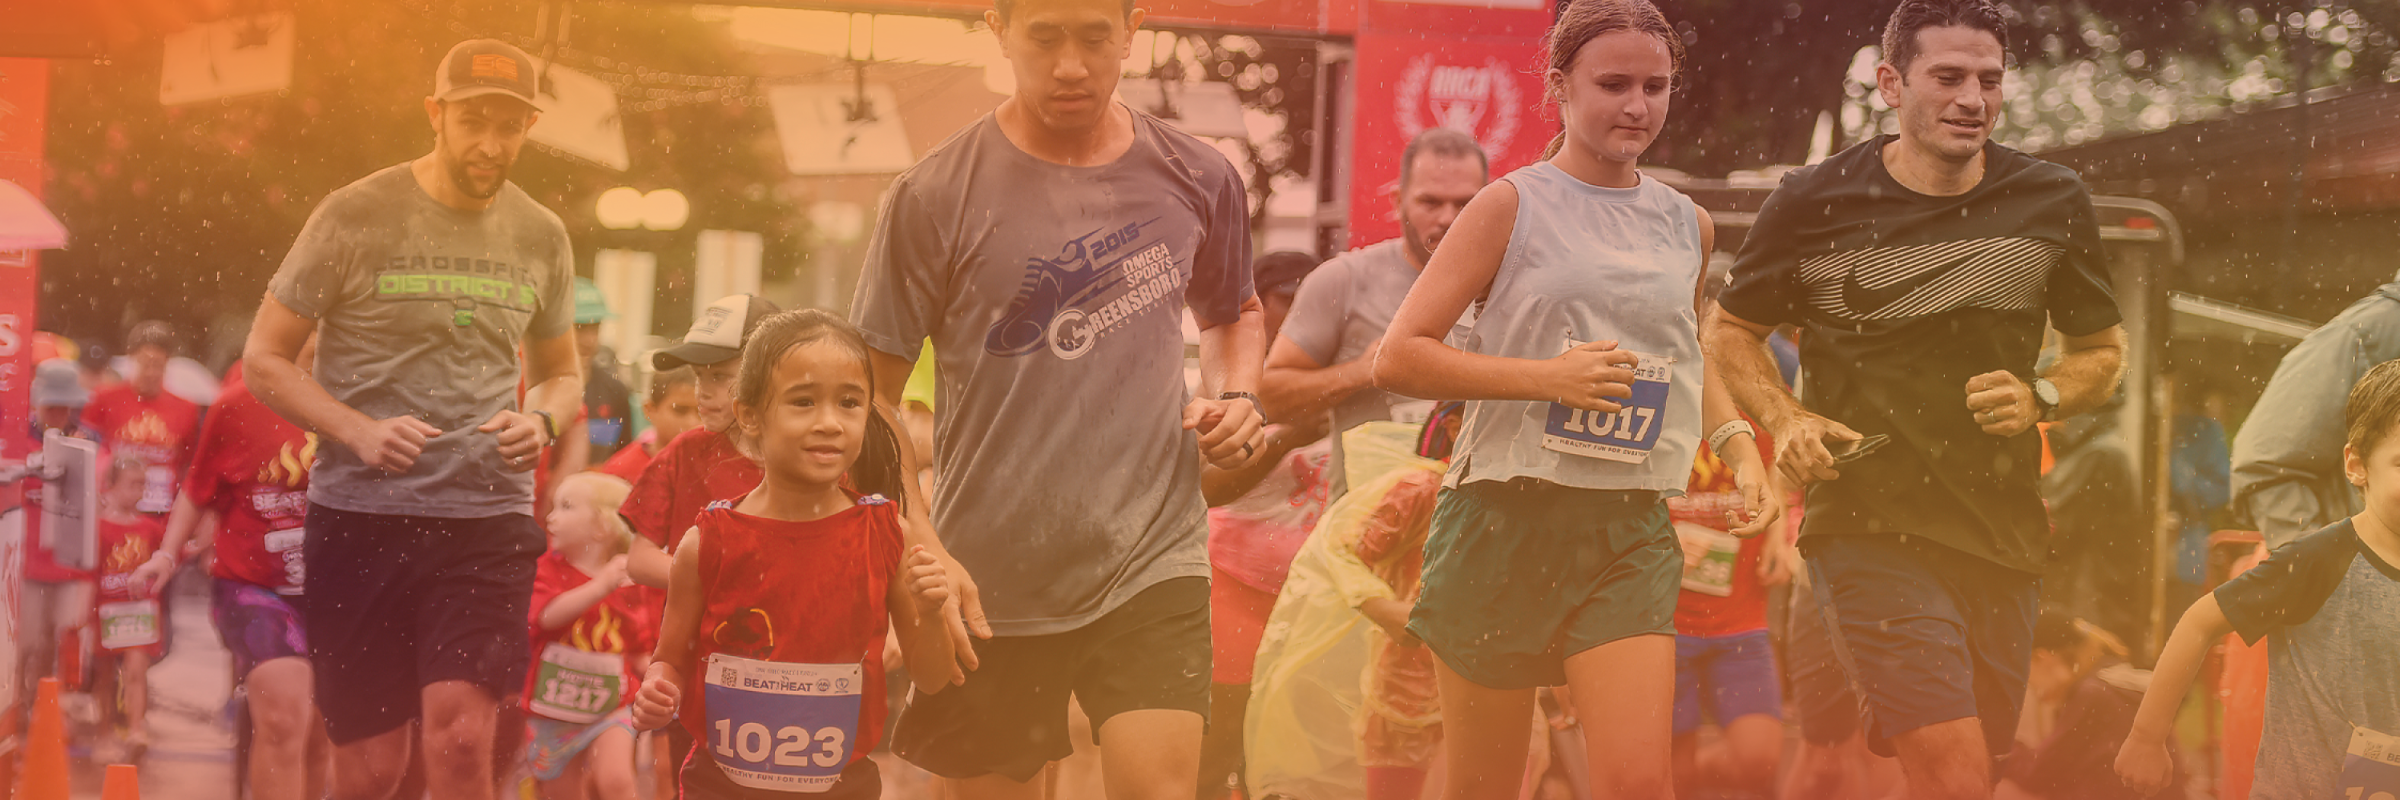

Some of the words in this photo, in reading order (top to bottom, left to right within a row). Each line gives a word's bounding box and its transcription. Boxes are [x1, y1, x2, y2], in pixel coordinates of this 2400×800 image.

[1089, 221, 1140, 260] 2015
[379, 274, 513, 300] DISTRICT
[1126, 256, 1174, 288] SPORTS
[1049, 267, 1181, 360] GREENSBORO
[1564, 405, 1656, 442] 1017
[1560, 439, 1591, 450] HEALTHY
[1608, 446, 1621, 454] FOR
[542, 678, 611, 712] 1217
[744, 677, 775, 690] BEAT
[780, 680, 813, 692] HEAT
[715, 718, 845, 768] 1023
[756, 773, 774, 782] FUN
[777, 775, 794, 784] FOR
